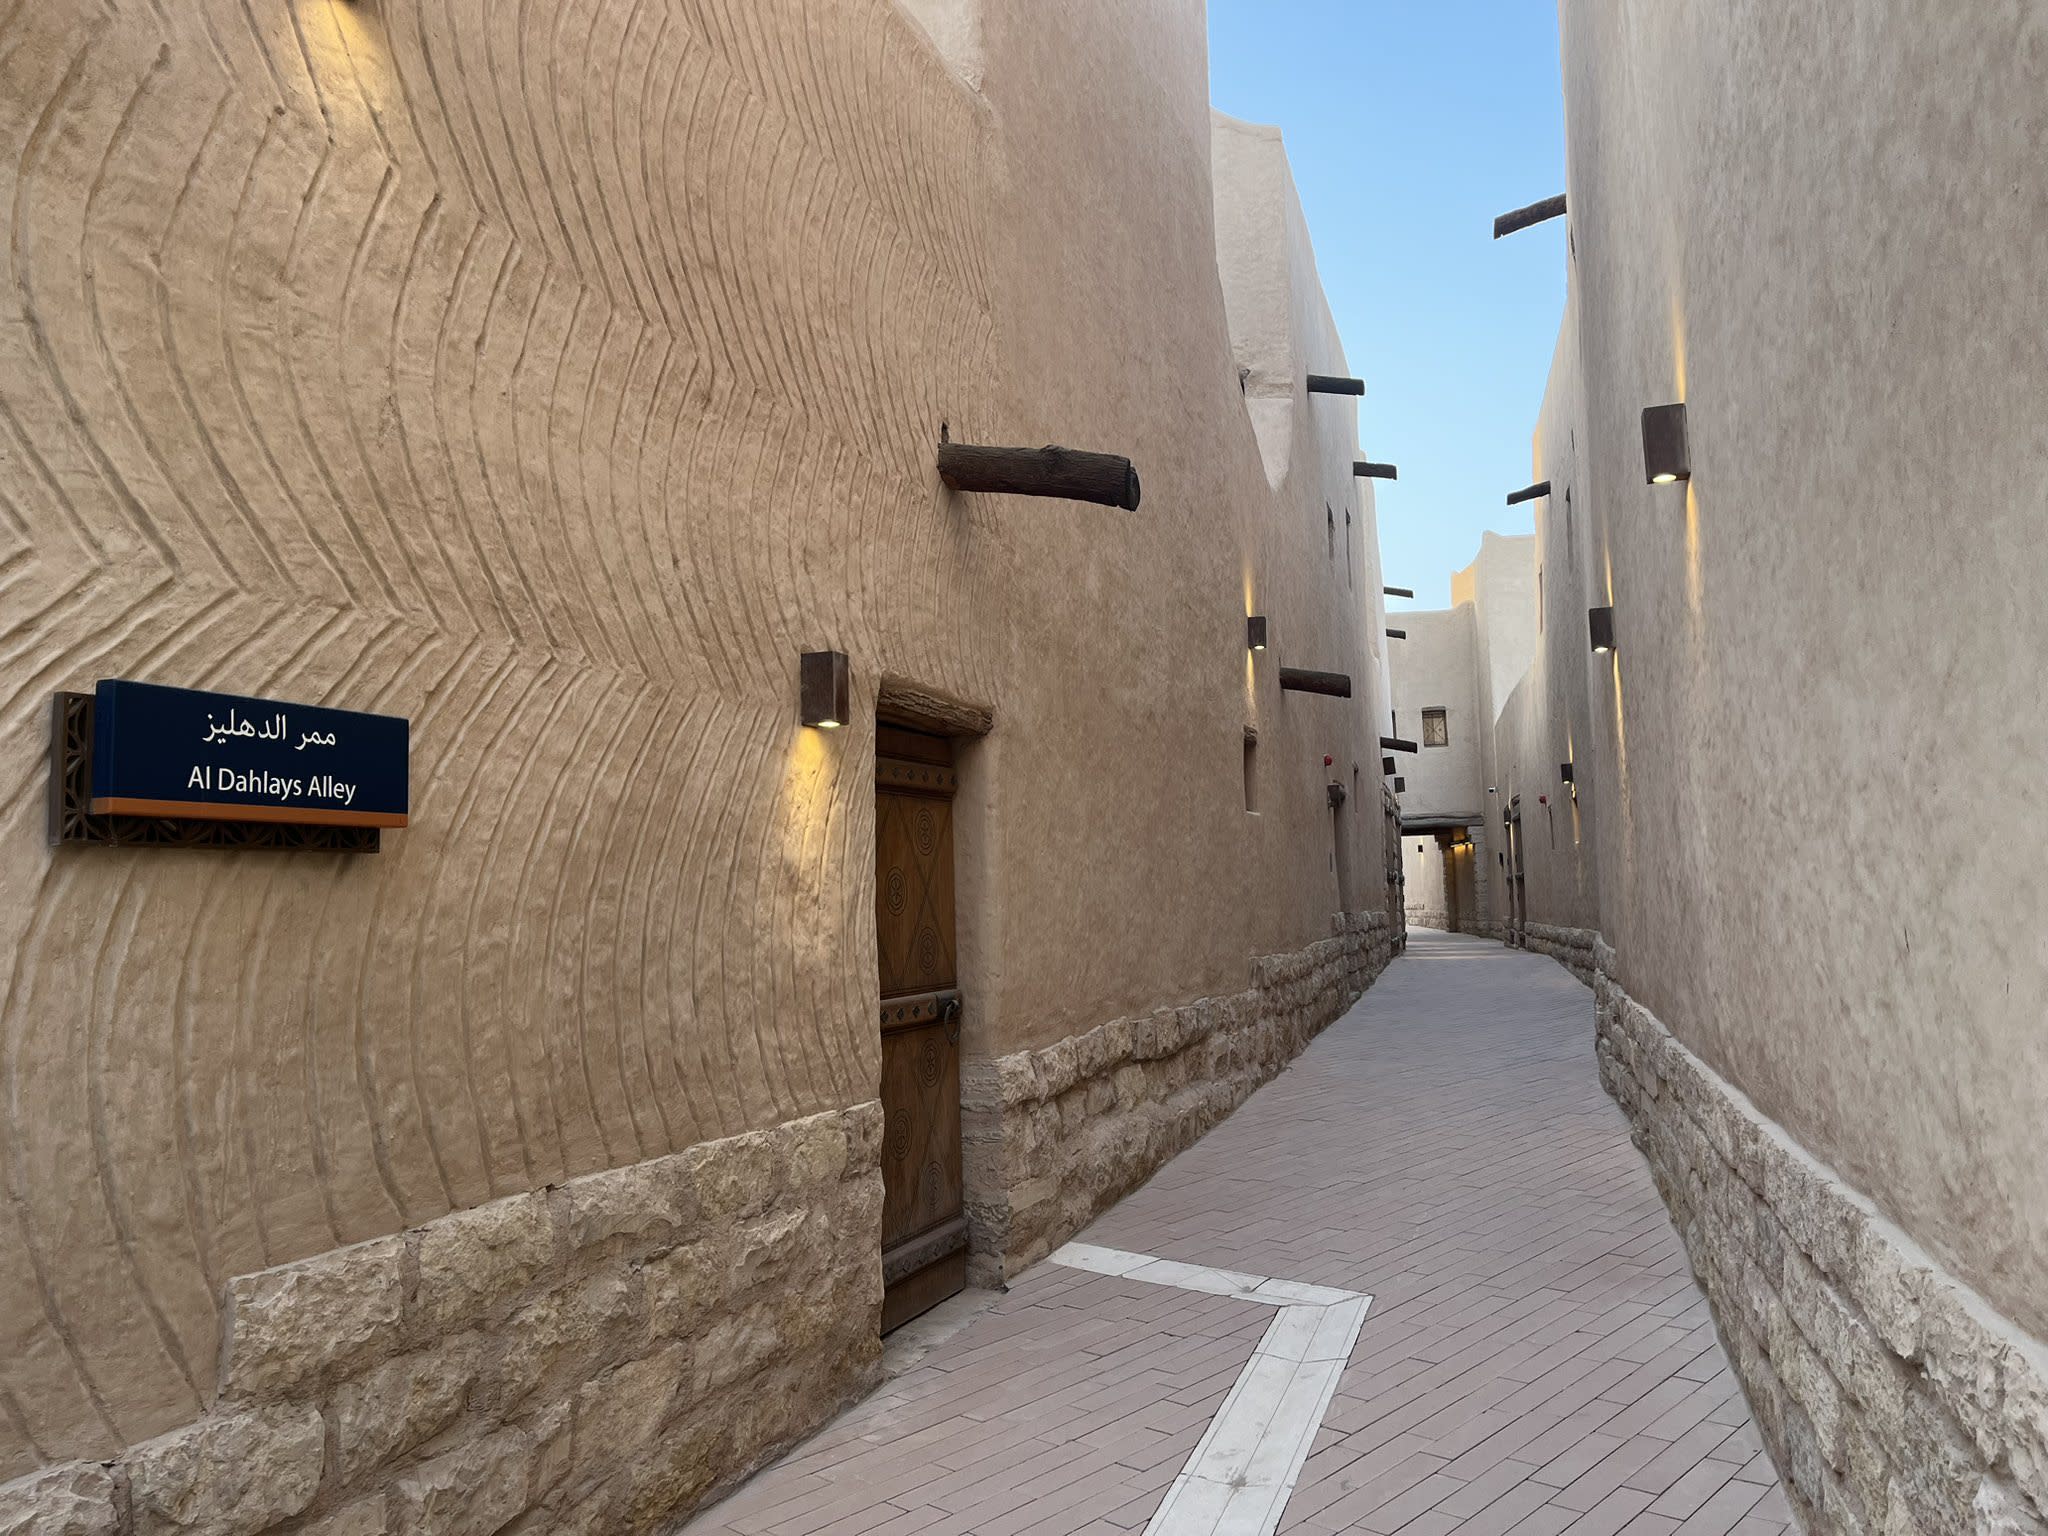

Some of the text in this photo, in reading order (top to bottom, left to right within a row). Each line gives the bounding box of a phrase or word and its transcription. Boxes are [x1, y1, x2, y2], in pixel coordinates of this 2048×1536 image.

[202, 708, 337, 751] ممر الدهليز
[187, 765, 356, 806] Al Dahlays Alley
